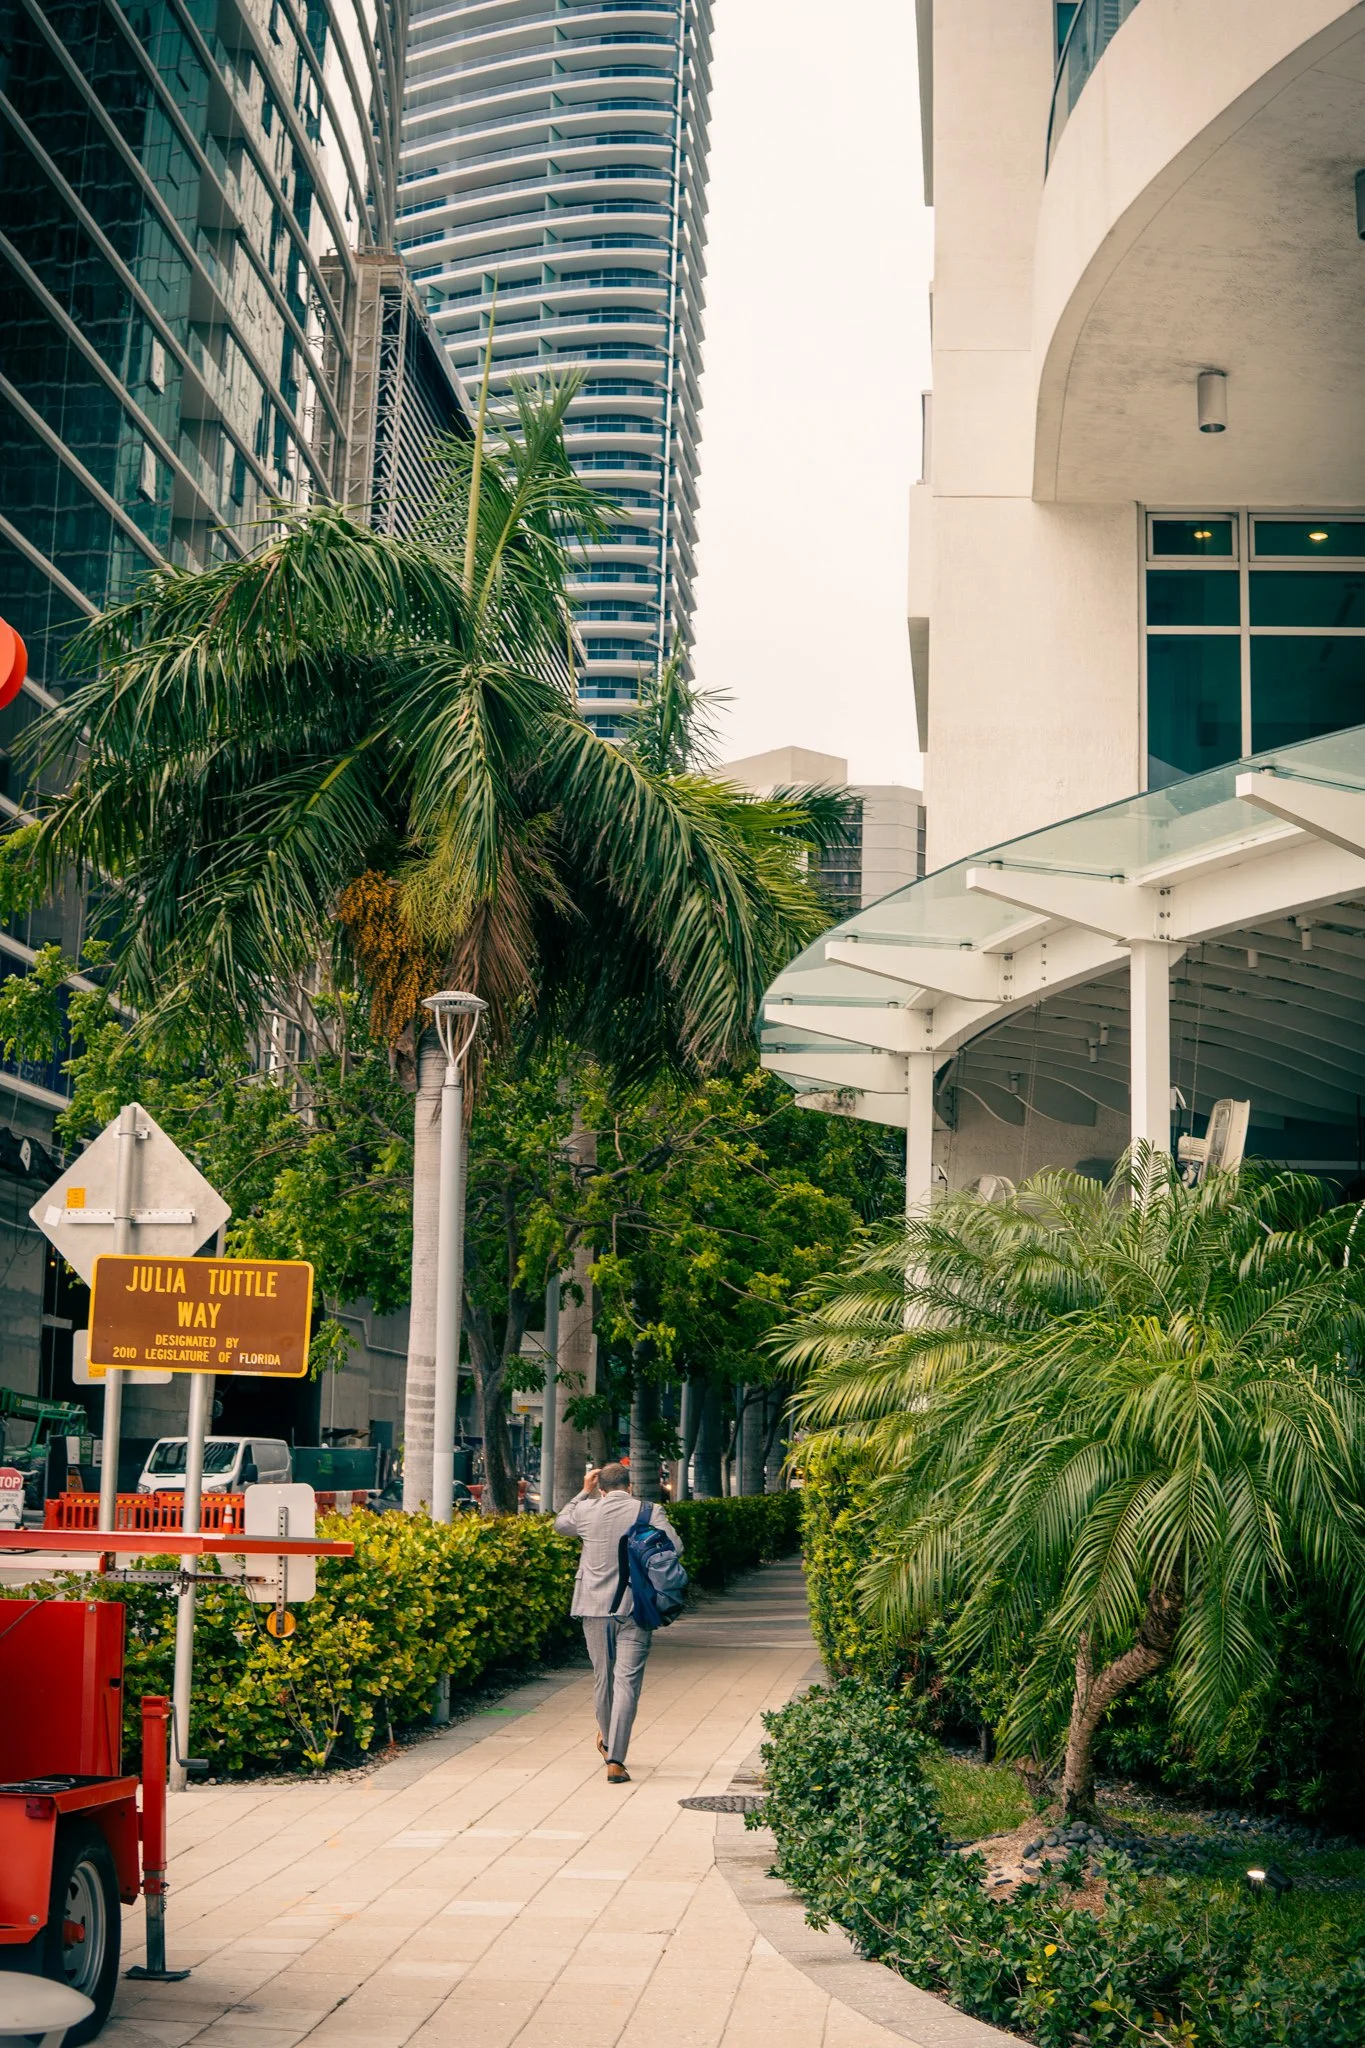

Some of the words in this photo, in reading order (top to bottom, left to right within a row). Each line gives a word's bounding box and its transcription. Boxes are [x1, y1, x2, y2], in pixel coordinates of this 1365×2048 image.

[125, 1265, 186, 1294] JULIA
[208, 1268, 279, 1298] TUTTLE
[177, 1301, 222, 1329] WAY
[155, 1334, 217, 1348] DESIGNATED
[225, 1337, 240, 1349] BY
[112, 1346, 137, 1359] 2010
[144, 1348, 210, 1363] LEGISLATURE
[218, 1351, 232, 1363] OF
[239, 1352, 281, 1366] FLORIDA
[0, 1476, 21, 1488] TOP
